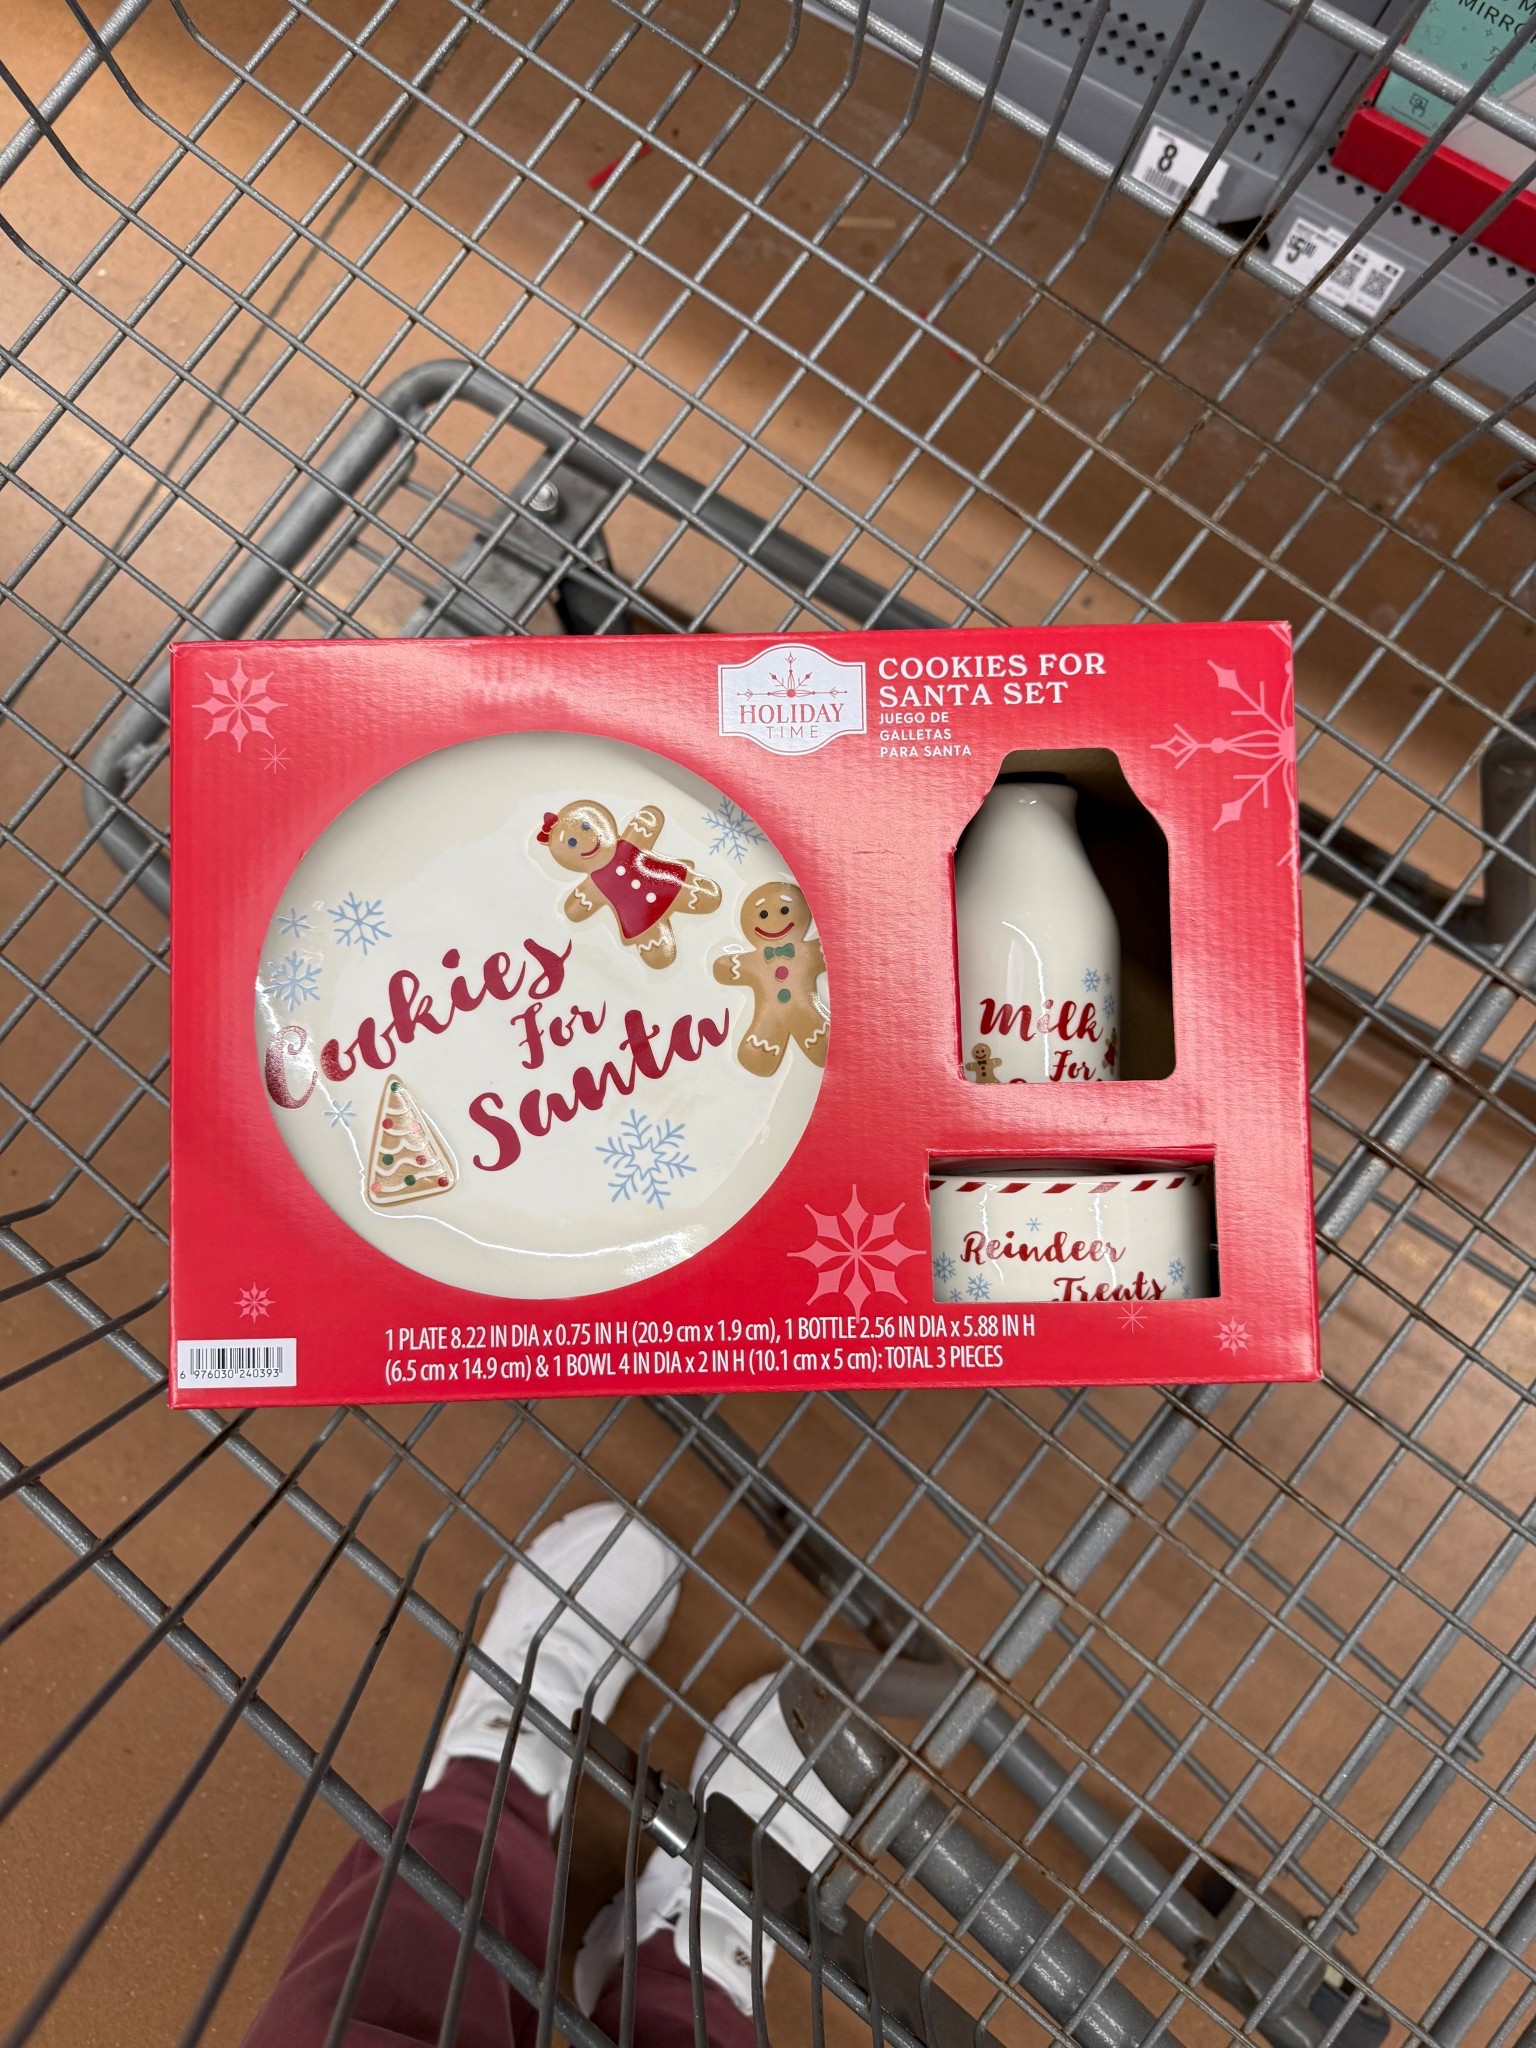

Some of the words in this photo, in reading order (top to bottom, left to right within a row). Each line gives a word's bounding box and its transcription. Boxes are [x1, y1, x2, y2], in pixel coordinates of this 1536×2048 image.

[1158, 144, 1178, 172] 8
[878, 655, 1028, 680] COOKIES
[1039, 653, 1106, 676] FOR
[879, 683, 993, 708] SANTA
[1003, 681, 1069, 705] SET
[739, 703, 844, 724] HOLIDAY
[879, 712, 926, 724] JUEGO
[930, 711, 949, 723] DE
[766, 725, 819, 739] TIME
[879, 728, 952, 741] GALLETAS
[880, 746, 919, 758] PARA
[924, 744, 972, 757] SANTA
[265, 938, 573, 1109] Cookies
[980, 998, 1103, 1042] Milk
[510, 1000, 606, 1069] For
[1050, 1050, 1097, 1082] For
[468, 1007, 730, 1171] Santa
[960, 1230, 1126, 1265] Reindeer
[386, 1329, 393, 1350] 1
[399, 1326, 448, 1350] PLATE
[451, 1326, 486, 1349] 8.22
[490, 1325, 507, 1347] IN
[512, 1324, 540, 1347] DIA
[543, 1329, 553, 1346] x
[555, 1323, 591, 1346] 0.75
[595, 1322, 611, 1345] IN
[616, 1321, 628, 1344] H
[632, 1321, 673, 1347] (20.9
[677, 1325, 700, 1342] cm
[704, 1324, 714, 1341] x
[717, 1319, 742, 1341] 1.9
[745, 1317, 781, 1344] cm),
[785, 1318, 792, 1340] 1
[798, 1316, 857, 1340] BOTTLE
[859, 1316, 895, 1338] 2.56
[899, 1315, 915, 1338] IN
[919, 1315, 948, 1337] DIA
[950, 1320, 960, 1337] x
[963, 1315, 998, 1337] 5.88
[1002, 1314, 1019, 1337] IN
[1023, 1314, 1035, 1336] H
[180, 1370, 186, 1379] 6
[194, 1369, 234, 1379] 976030
[239, 1368, 279, 1378] 240393
[385, 1359, 417, 1386] (6.5
[420, 1363, 445, 1381] cm
[449, 1363, 459, 1380] x
[462, 1357, 498, 1380] 14.9
[501, 1355, 532, 1381] cm)
[536, 1354, 549, 1377] &
[553, 1355, 561, 1377] 1
[567, 1352, 616, 1377] BOWL
[619, 1353, 630, 1374] 4
[633, 1352, 650, 1374] IN
[654, 1351, 682, 1374] DIA
[685, 1356, 695, 1373] x
[698, 1351, 708, 1372] 2
[712, 1350, 729, 1372] IN
[733, 1349, 745, 1372] H
[749, 1348, 787, 1375] (10.1
[793, 1353, 817, 1371] cm
[820, 1353, 831, 1370] x
[834, 1348, 843, 1370] 5
[847, 1346, 883, 1373] cm):
[884, 1346, 933, 1369] TOTAL
[936, 1346, 946, 1368] 3
[951, 1345, 1003, 1368] PIECES
